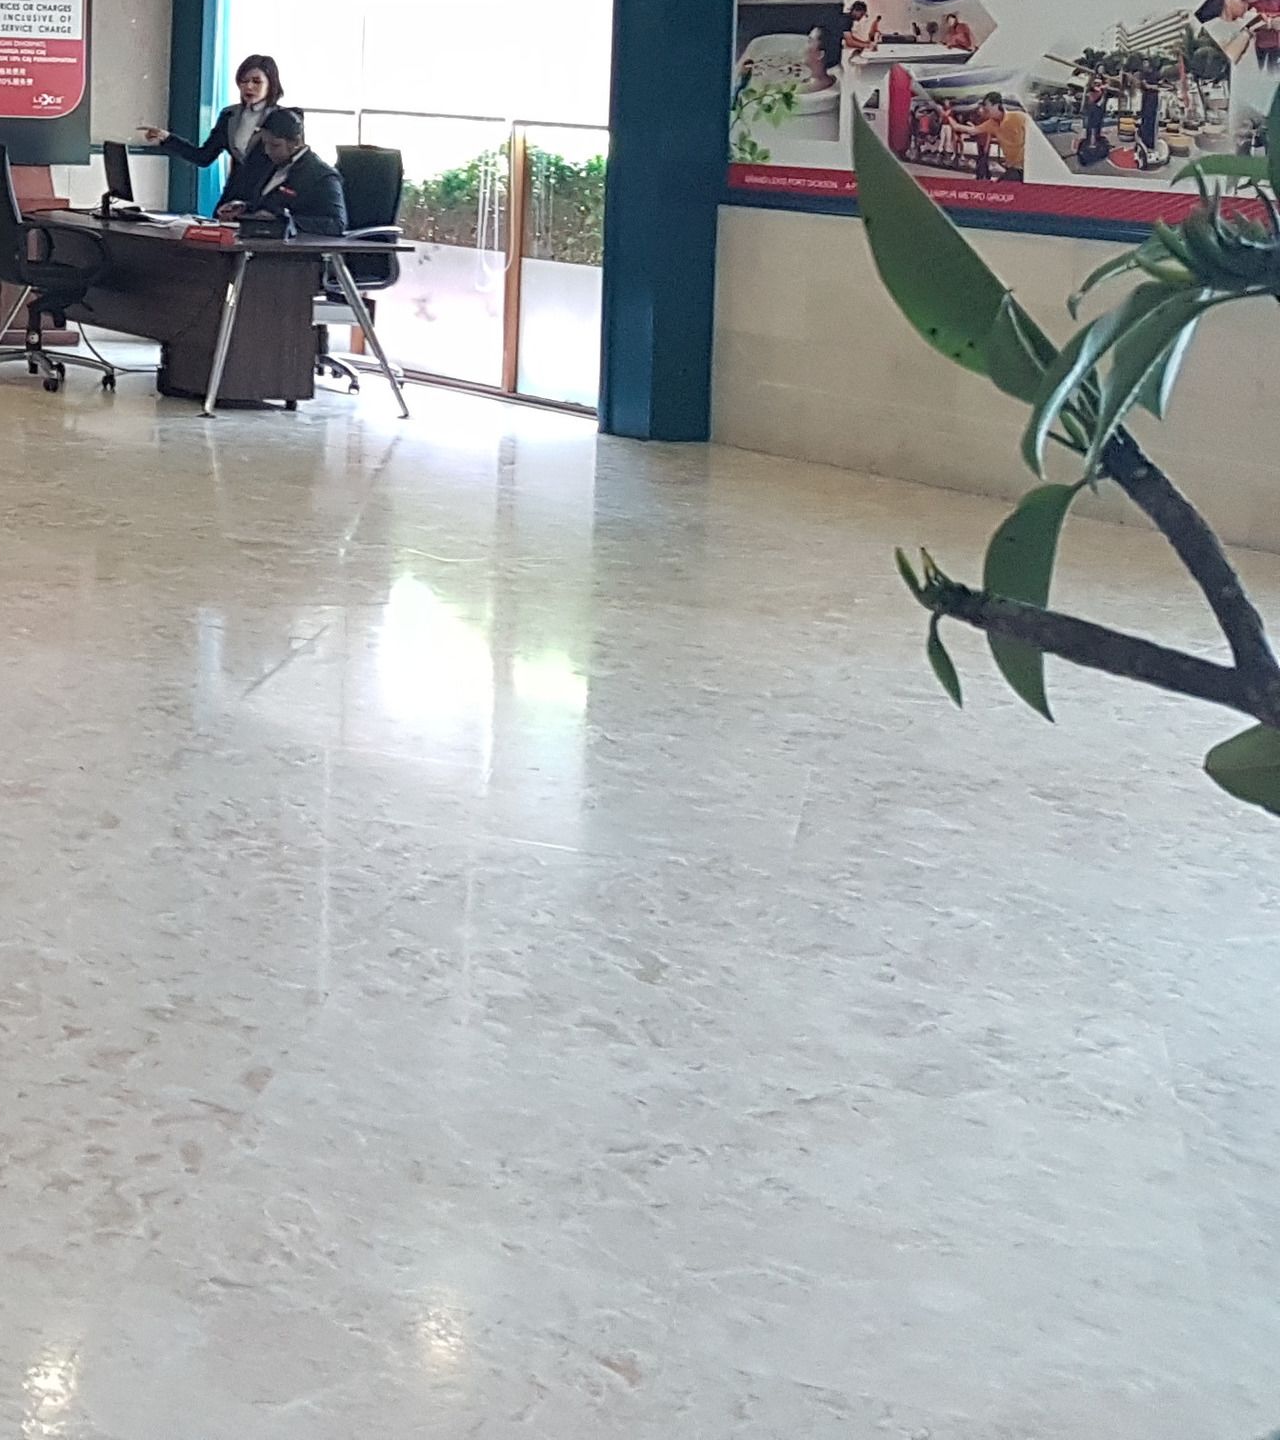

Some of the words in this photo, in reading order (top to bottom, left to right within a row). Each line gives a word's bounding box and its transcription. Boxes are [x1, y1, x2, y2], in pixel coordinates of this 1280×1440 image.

[22, 3, 34, 11] OR
[36, 4, 72, 12] CHARGES
[3, 13, 53, 22] INCLUSIVE
[59, 15, 72, 23] OF
[0, 24, 32, 33] SERVICE
[39, 25, 72, 34] CHARGE
